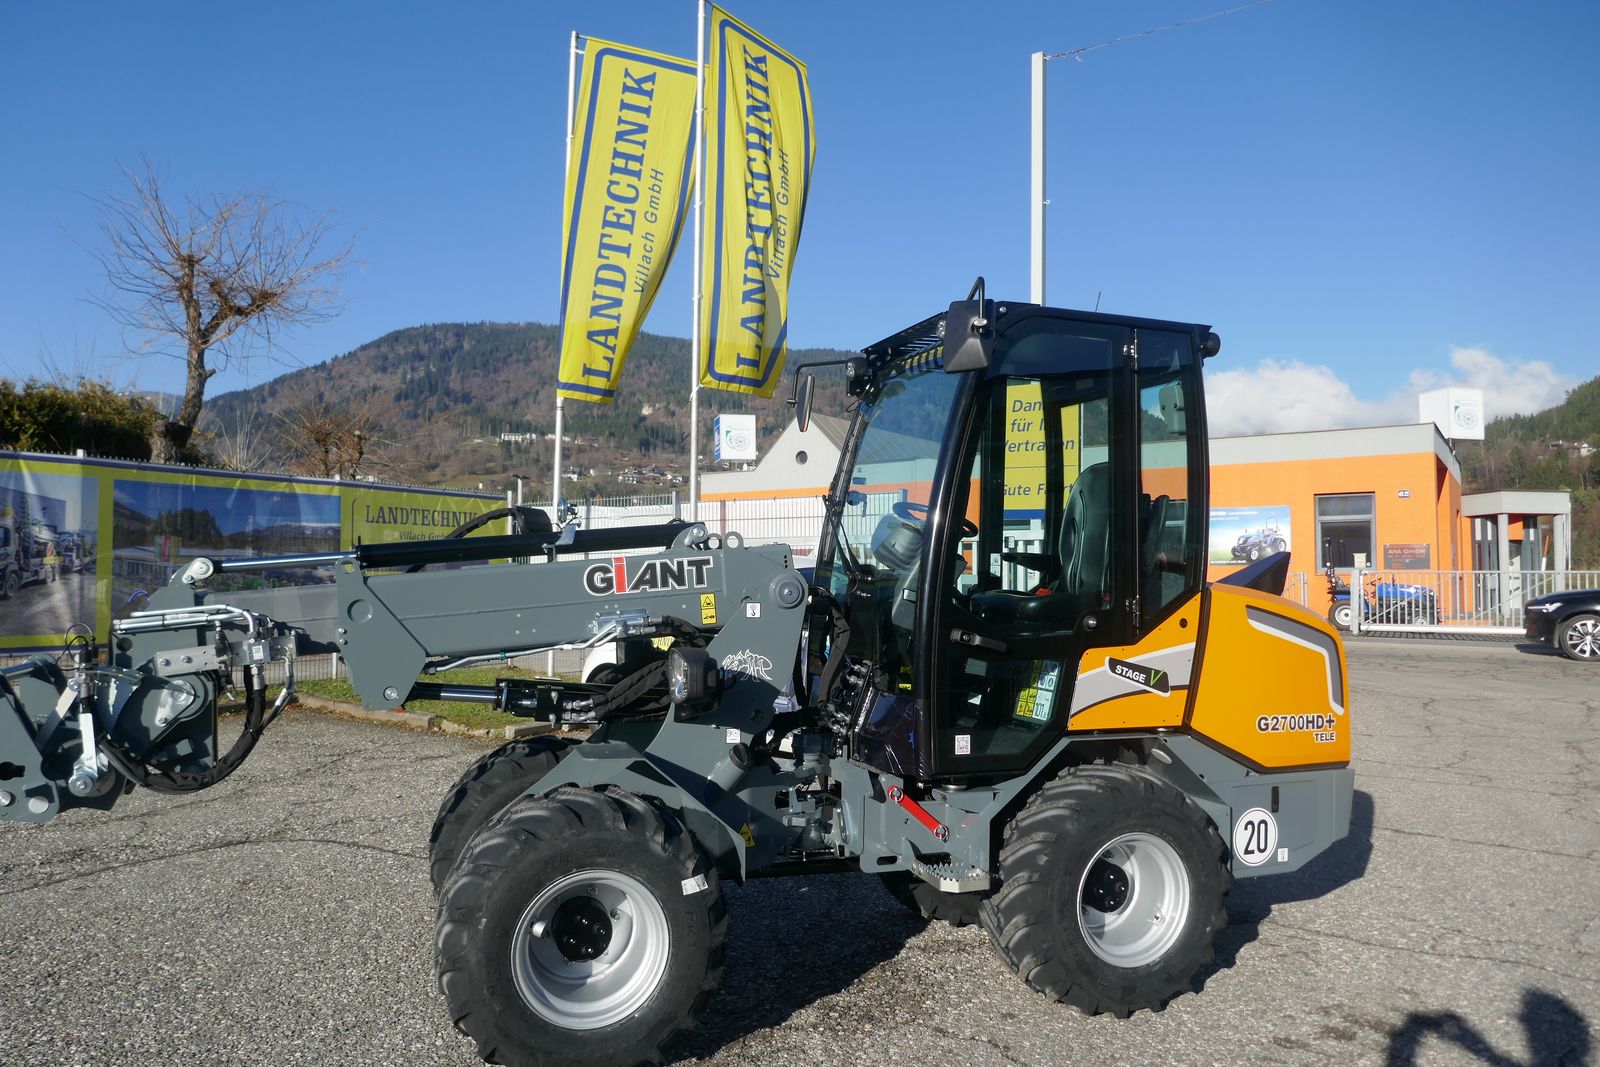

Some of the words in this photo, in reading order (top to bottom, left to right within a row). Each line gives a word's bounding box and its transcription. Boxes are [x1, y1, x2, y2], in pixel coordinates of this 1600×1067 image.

[776, 147, 789, 206] GmbH
[643, 167, 664, 224] GmbH
[736, 43, 773, 373] LANDTECHNIK
[582, 67, 657, 384] LANDTECHNIK
[765, 214, 788, 278] Villach
[633, 231, 655, 293] Villach
[1012, 399, 1044, 413] Dan
[1010, 417, 1033, 433] für
[1005, 438, 1075, 453] ertran
[399, 530, 426, 541] Villach
[1115, 664, 1147, 683] STAGE
[1150, 669, 1167, 686] V
[1256, 713, 1336, 732] G2700HD+
[1314, 732, 1336, 743] TELE
[1243, 819, 1269, 856] 20
